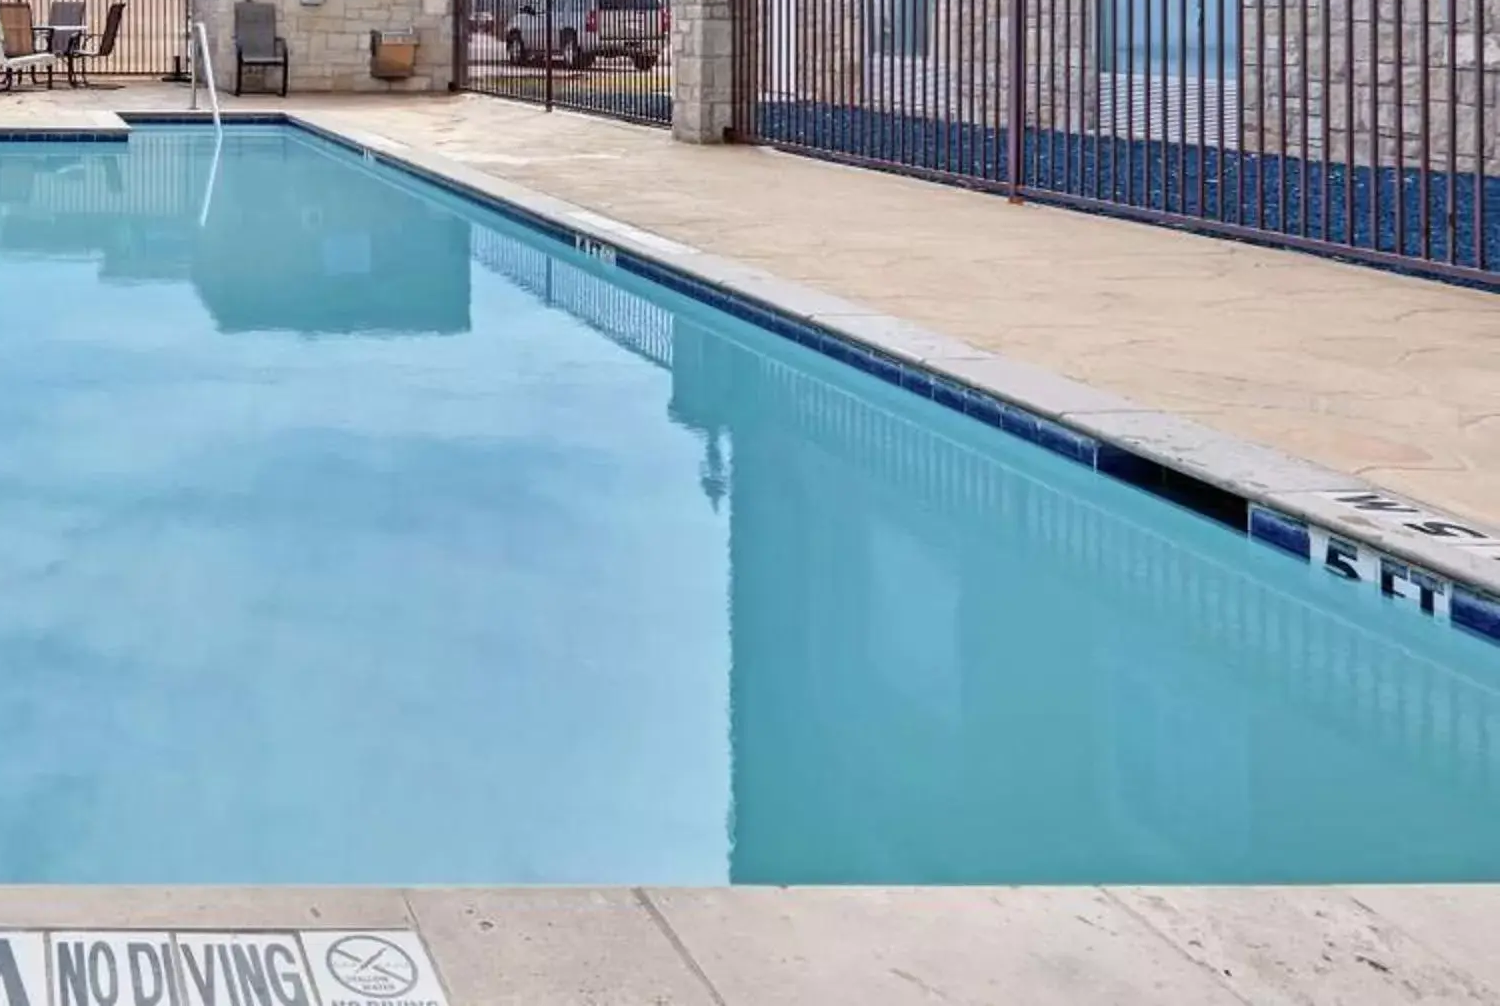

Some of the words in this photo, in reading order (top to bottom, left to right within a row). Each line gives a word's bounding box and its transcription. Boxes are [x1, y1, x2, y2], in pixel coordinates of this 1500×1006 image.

[1324, 535, 1362, 582] 5
[1381, 557, 1446, 618] FT
[56, 941, 118, 1006] NO
[127, 943, 313, 1006] DIVING
